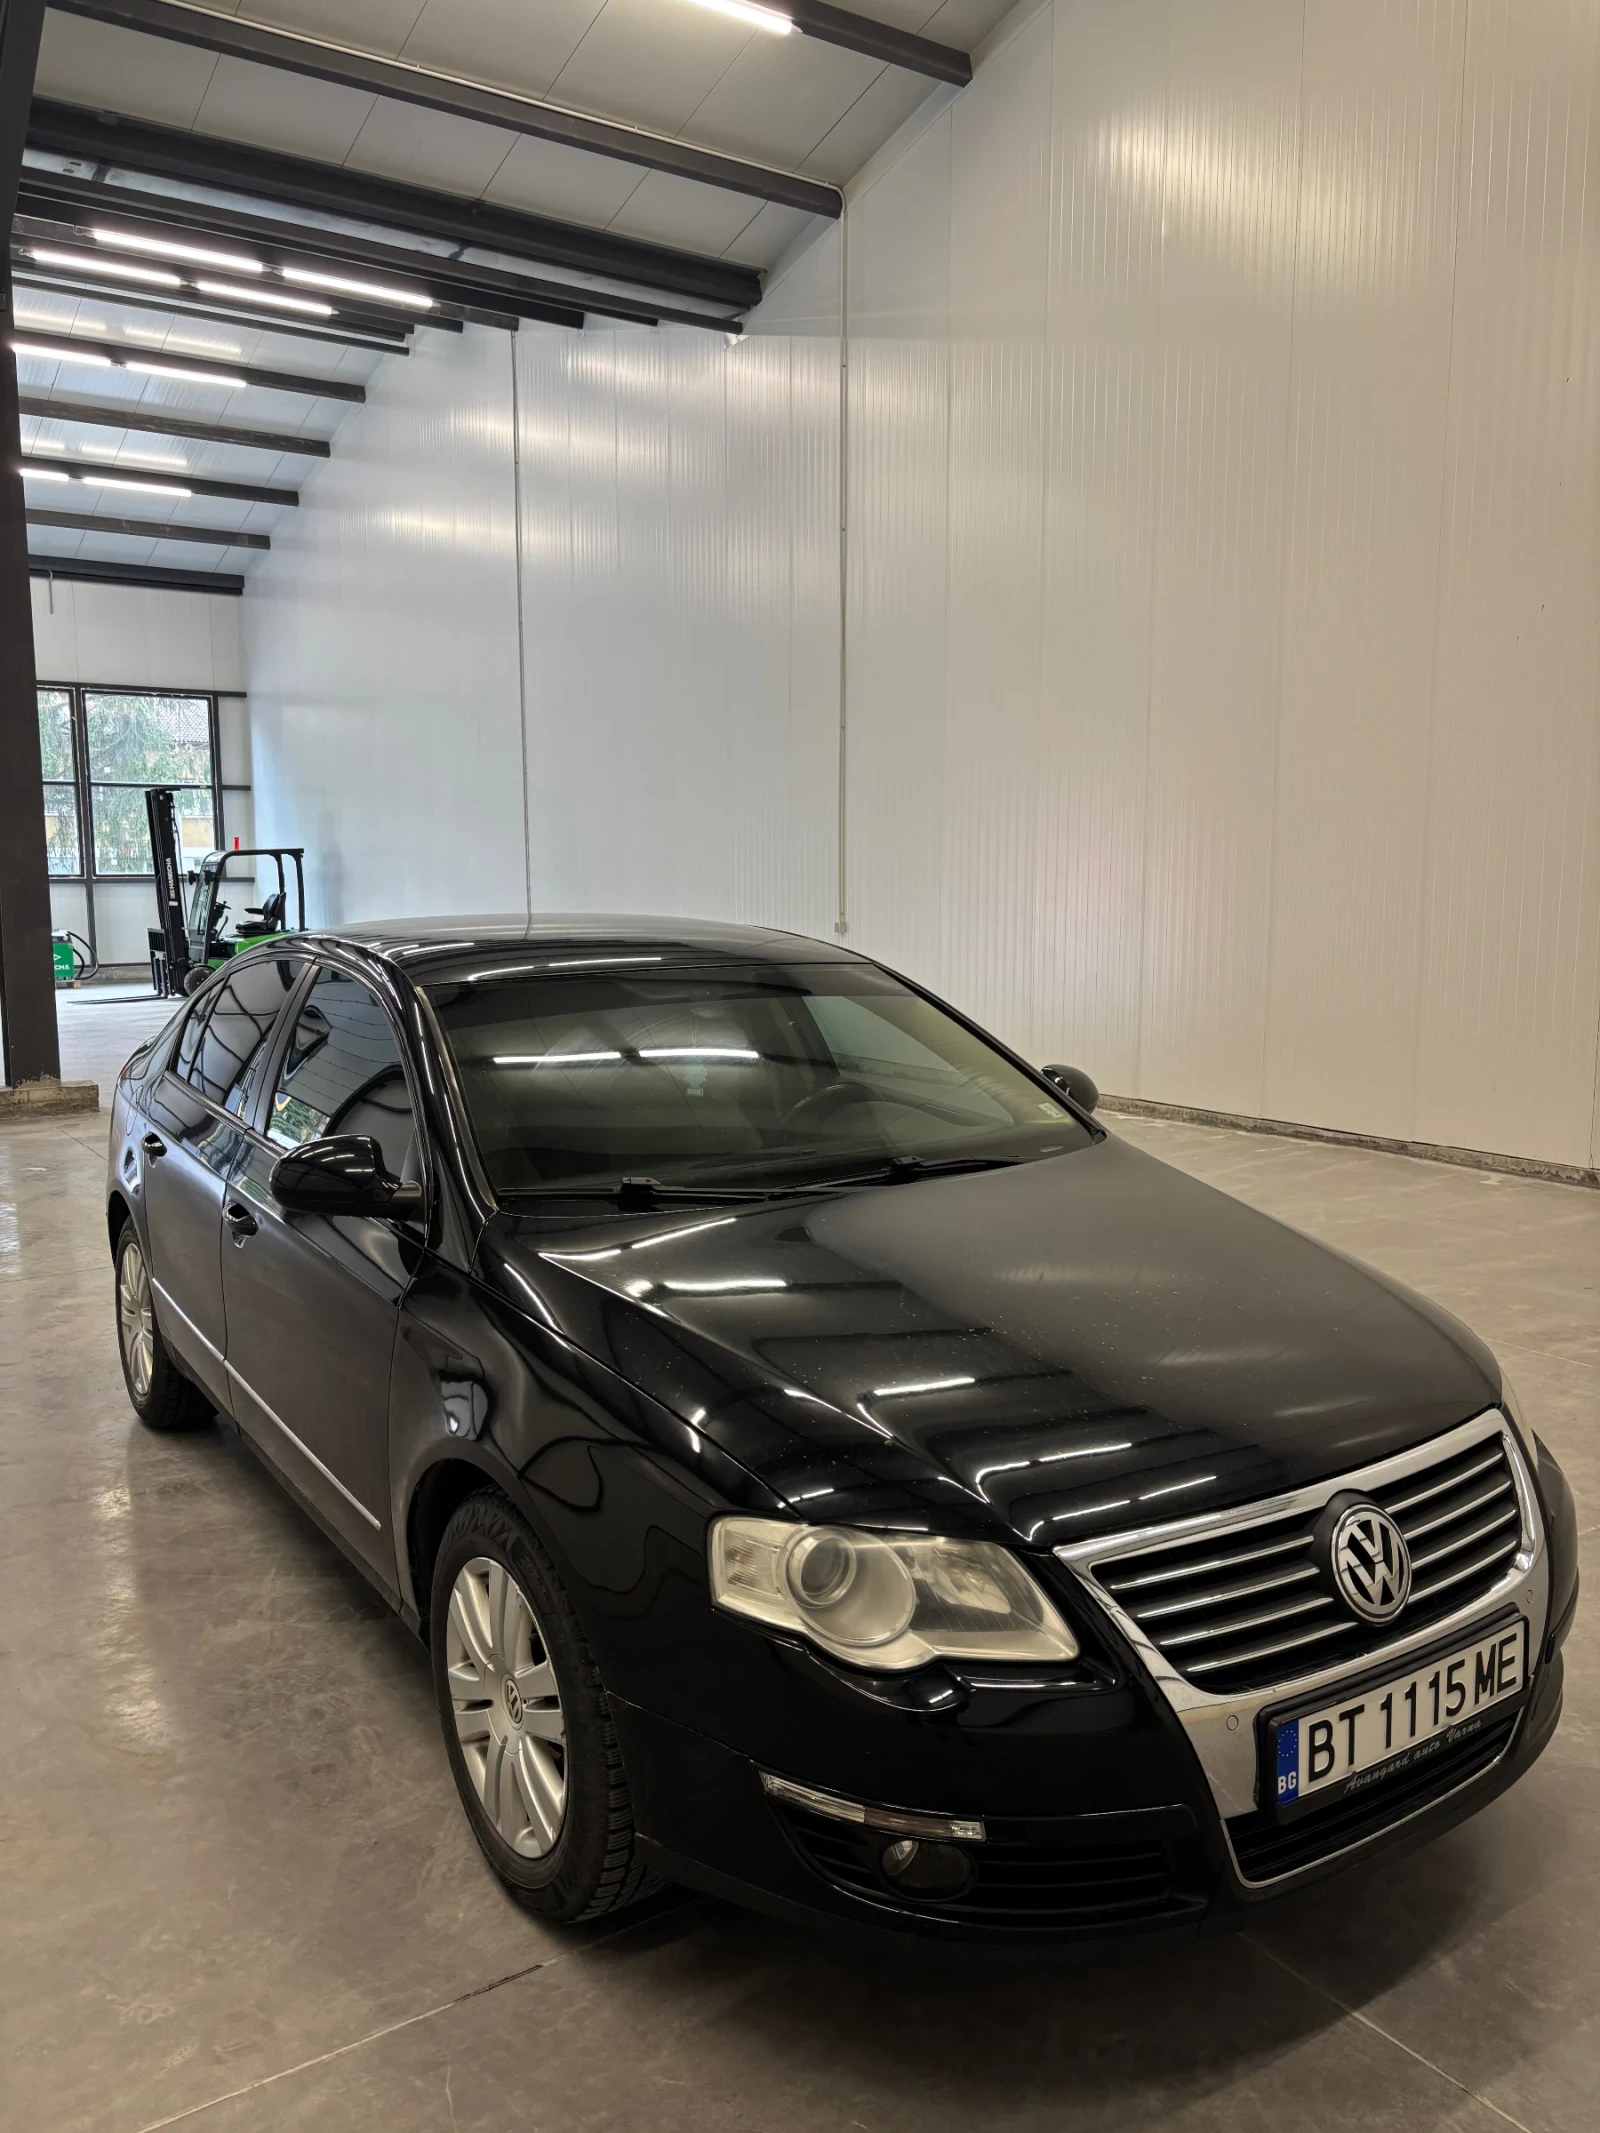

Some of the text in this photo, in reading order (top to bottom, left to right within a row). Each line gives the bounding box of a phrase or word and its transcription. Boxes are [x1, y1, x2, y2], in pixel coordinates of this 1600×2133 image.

[165, 857, 175, 889] HANGCHA
[1336, 1509, 1408, 1617] VW
[1308, 1632, 1518, 1783] BT 1115 ME
[1277, 1771, 1297, 1794] BG
[1343, 1720, 1482, 1794] Avangard auto Varna
